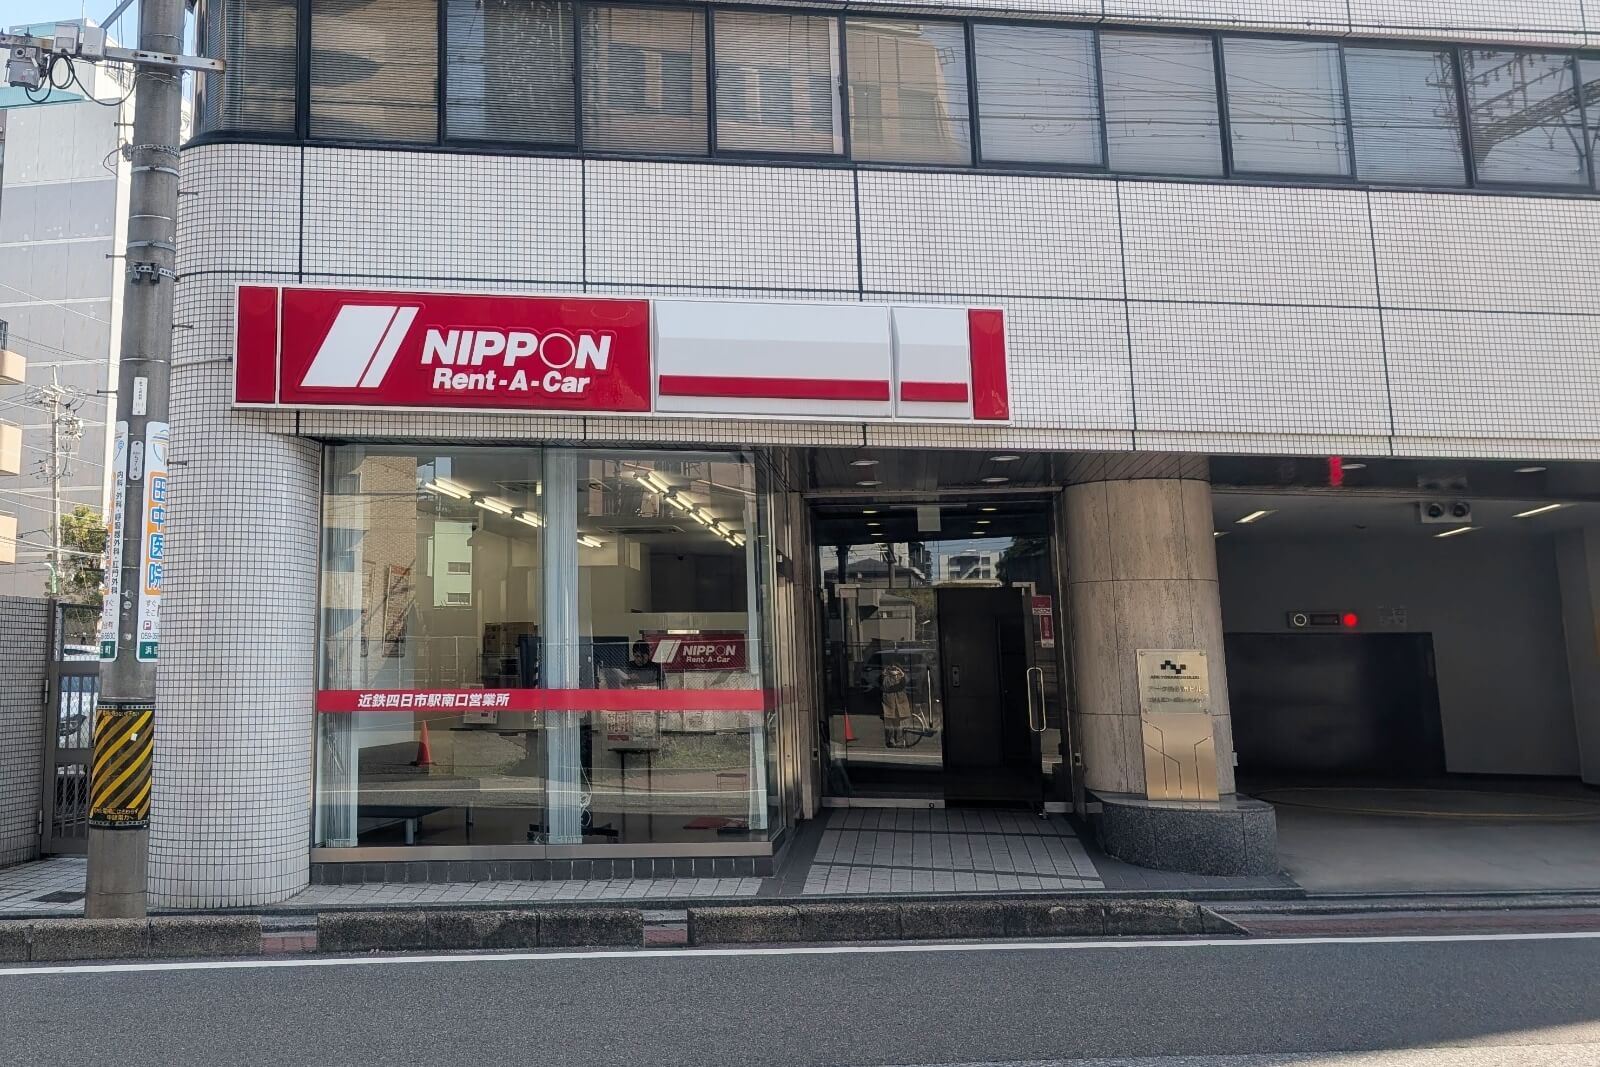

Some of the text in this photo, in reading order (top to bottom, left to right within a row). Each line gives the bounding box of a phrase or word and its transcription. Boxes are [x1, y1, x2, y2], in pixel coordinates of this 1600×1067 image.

[420, 329, 612, 370] NIPPON
[432, 367, 591, 393] Rent-A-Car
[148, 476, 166, 589] 田中医院
[682, 645, 737, 656] NIPPON
[685, 655, 731, 663] Rent-A-Car
[358, 693, 510, 708] 近鉄四日市駅南口営業所
